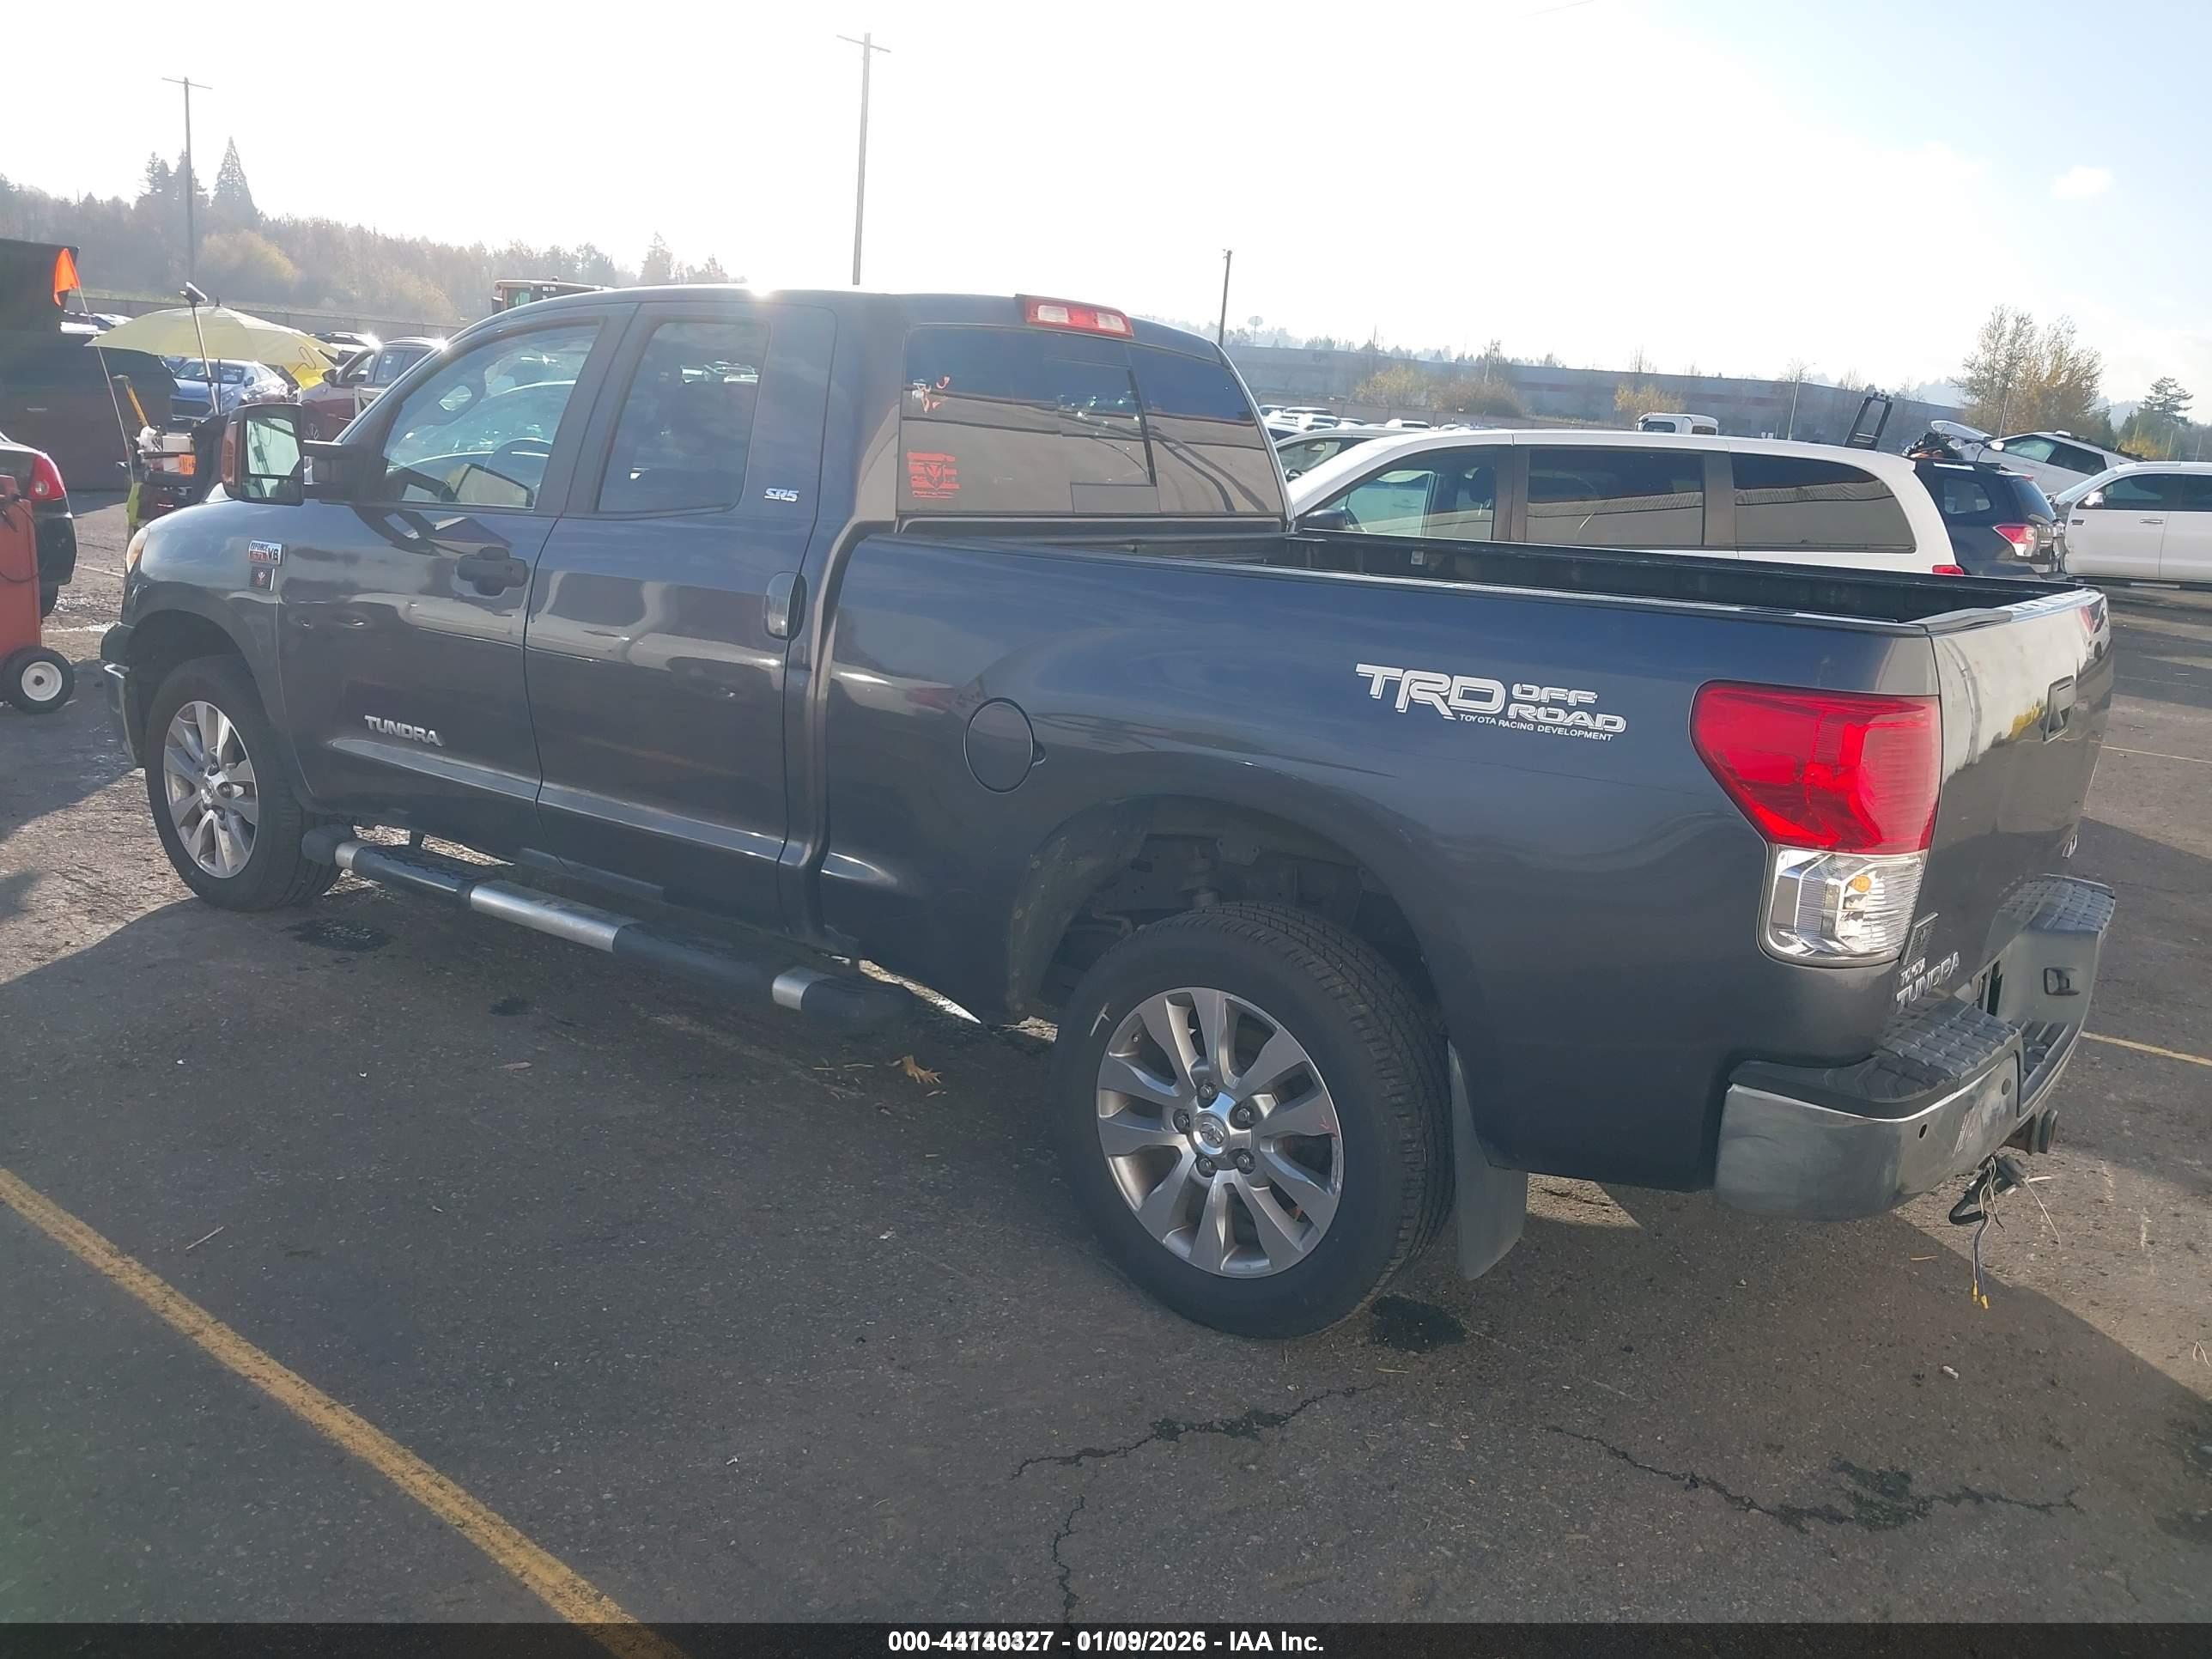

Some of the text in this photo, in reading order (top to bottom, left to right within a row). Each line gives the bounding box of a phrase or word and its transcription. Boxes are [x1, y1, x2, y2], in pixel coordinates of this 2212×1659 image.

[764, 488, 799, 502] SR5
[1355, 663, 1506, 720] TRD
[1512, 683, 1598, 707] OFF
[363, 714, 443, 747] TUNDRA
[1460, 714, 1614, 743] TOYOTA RACING DEVELOPMENT
[1507, 703, 1627, 733] ROAD
[1894, 951, 1960, 1015] TUNDRA
